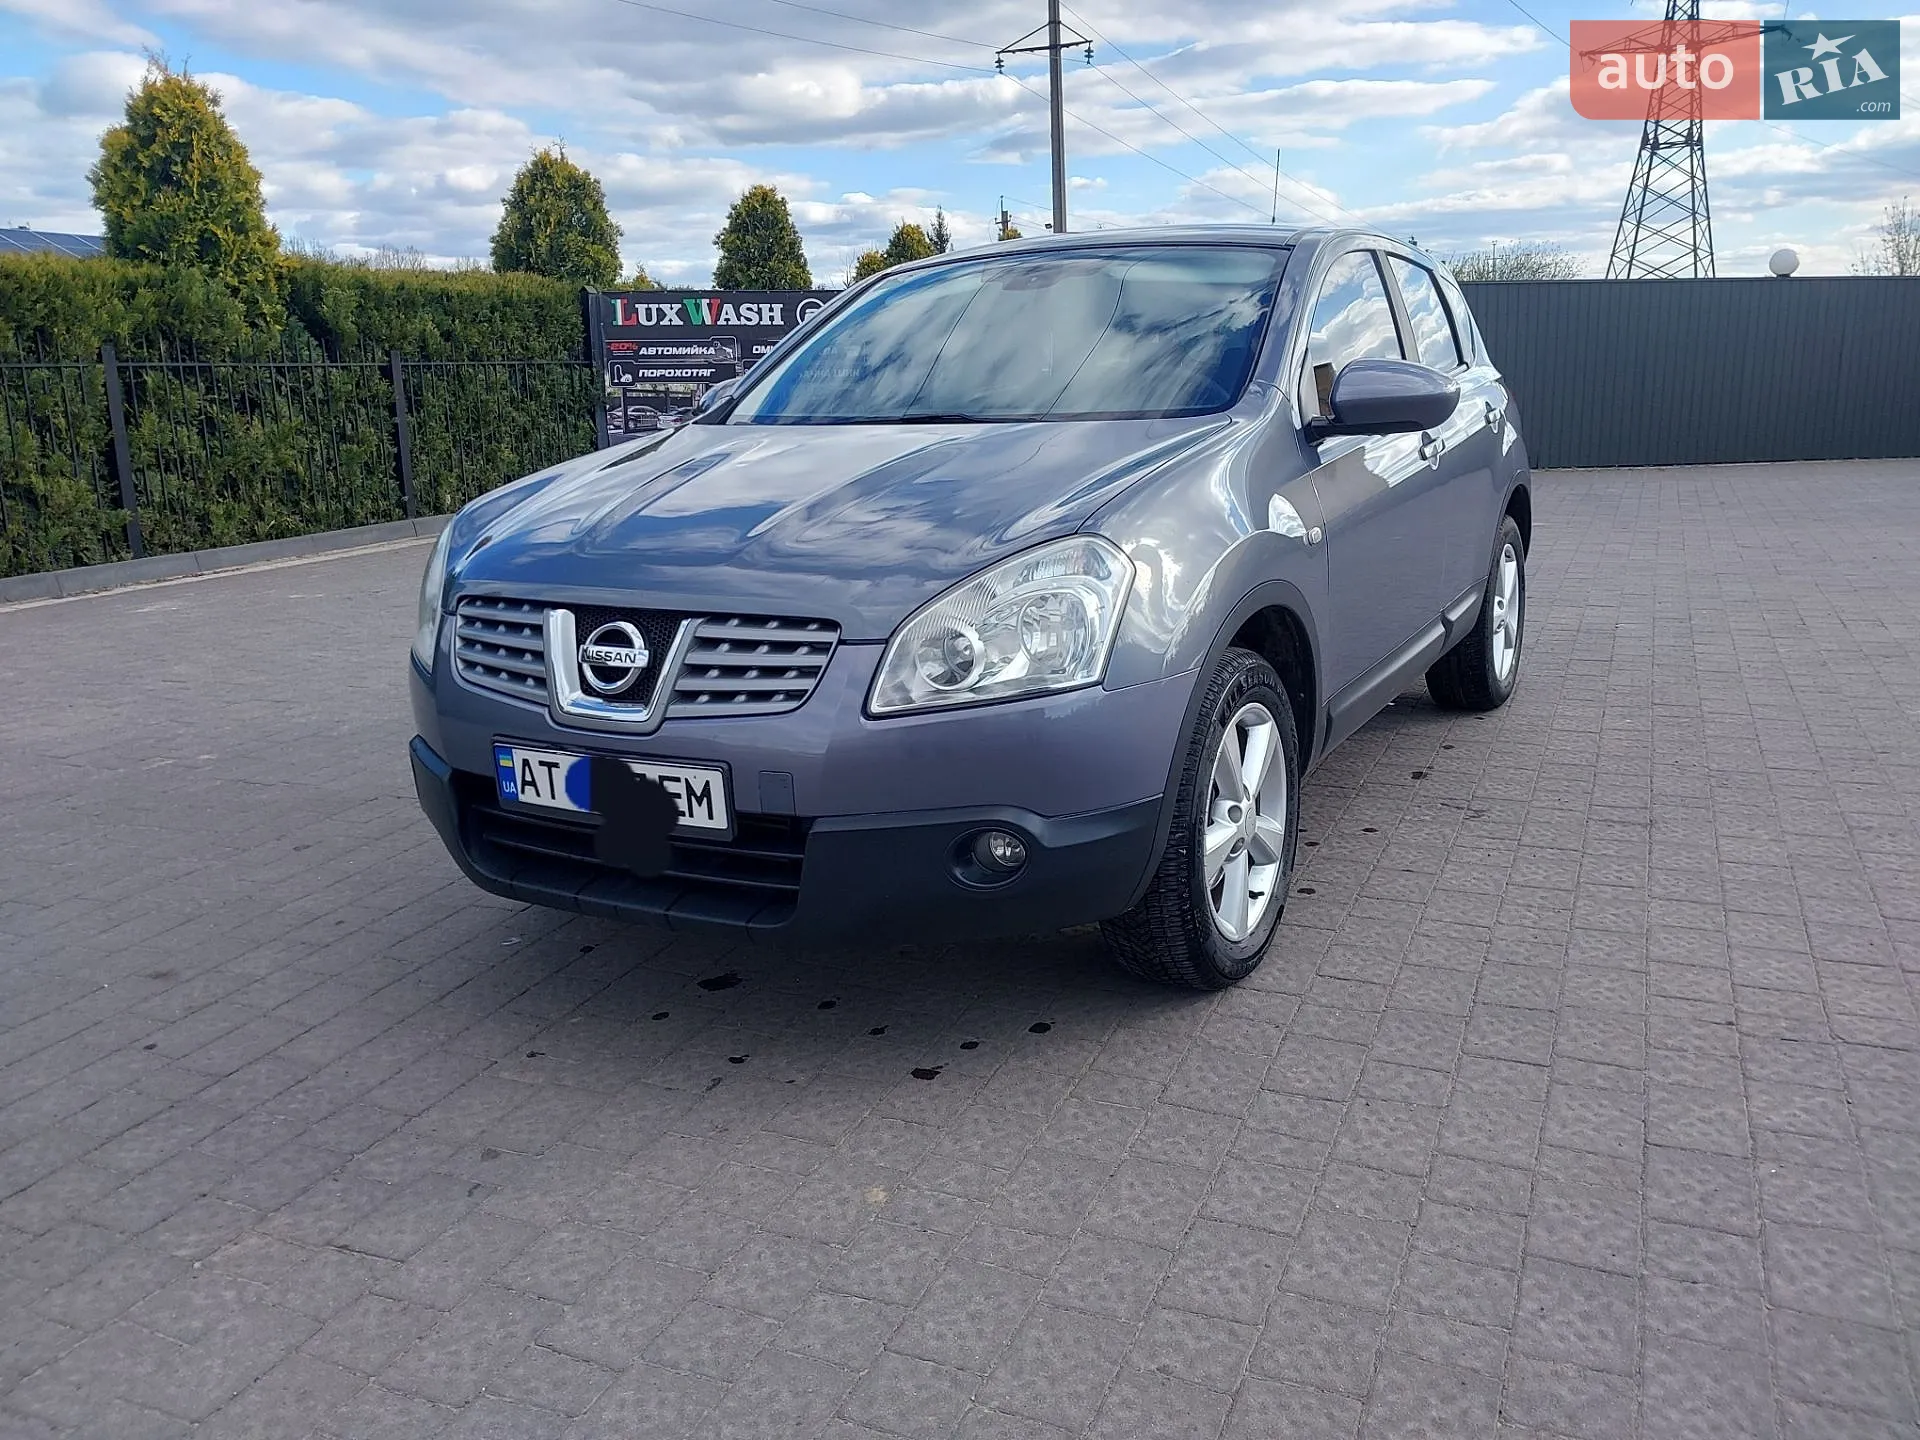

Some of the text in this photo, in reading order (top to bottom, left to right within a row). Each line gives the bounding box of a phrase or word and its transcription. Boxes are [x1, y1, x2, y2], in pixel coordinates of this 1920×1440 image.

[639, 345, 716, 355] АВТОМИЙКА
[638, 369, 716, 378] ПОРОХОТЯГ
[584, 647, 637, 664] NISSAN
[520, 758, 560, 800] AT
[502, 780, 517, 794] UA
